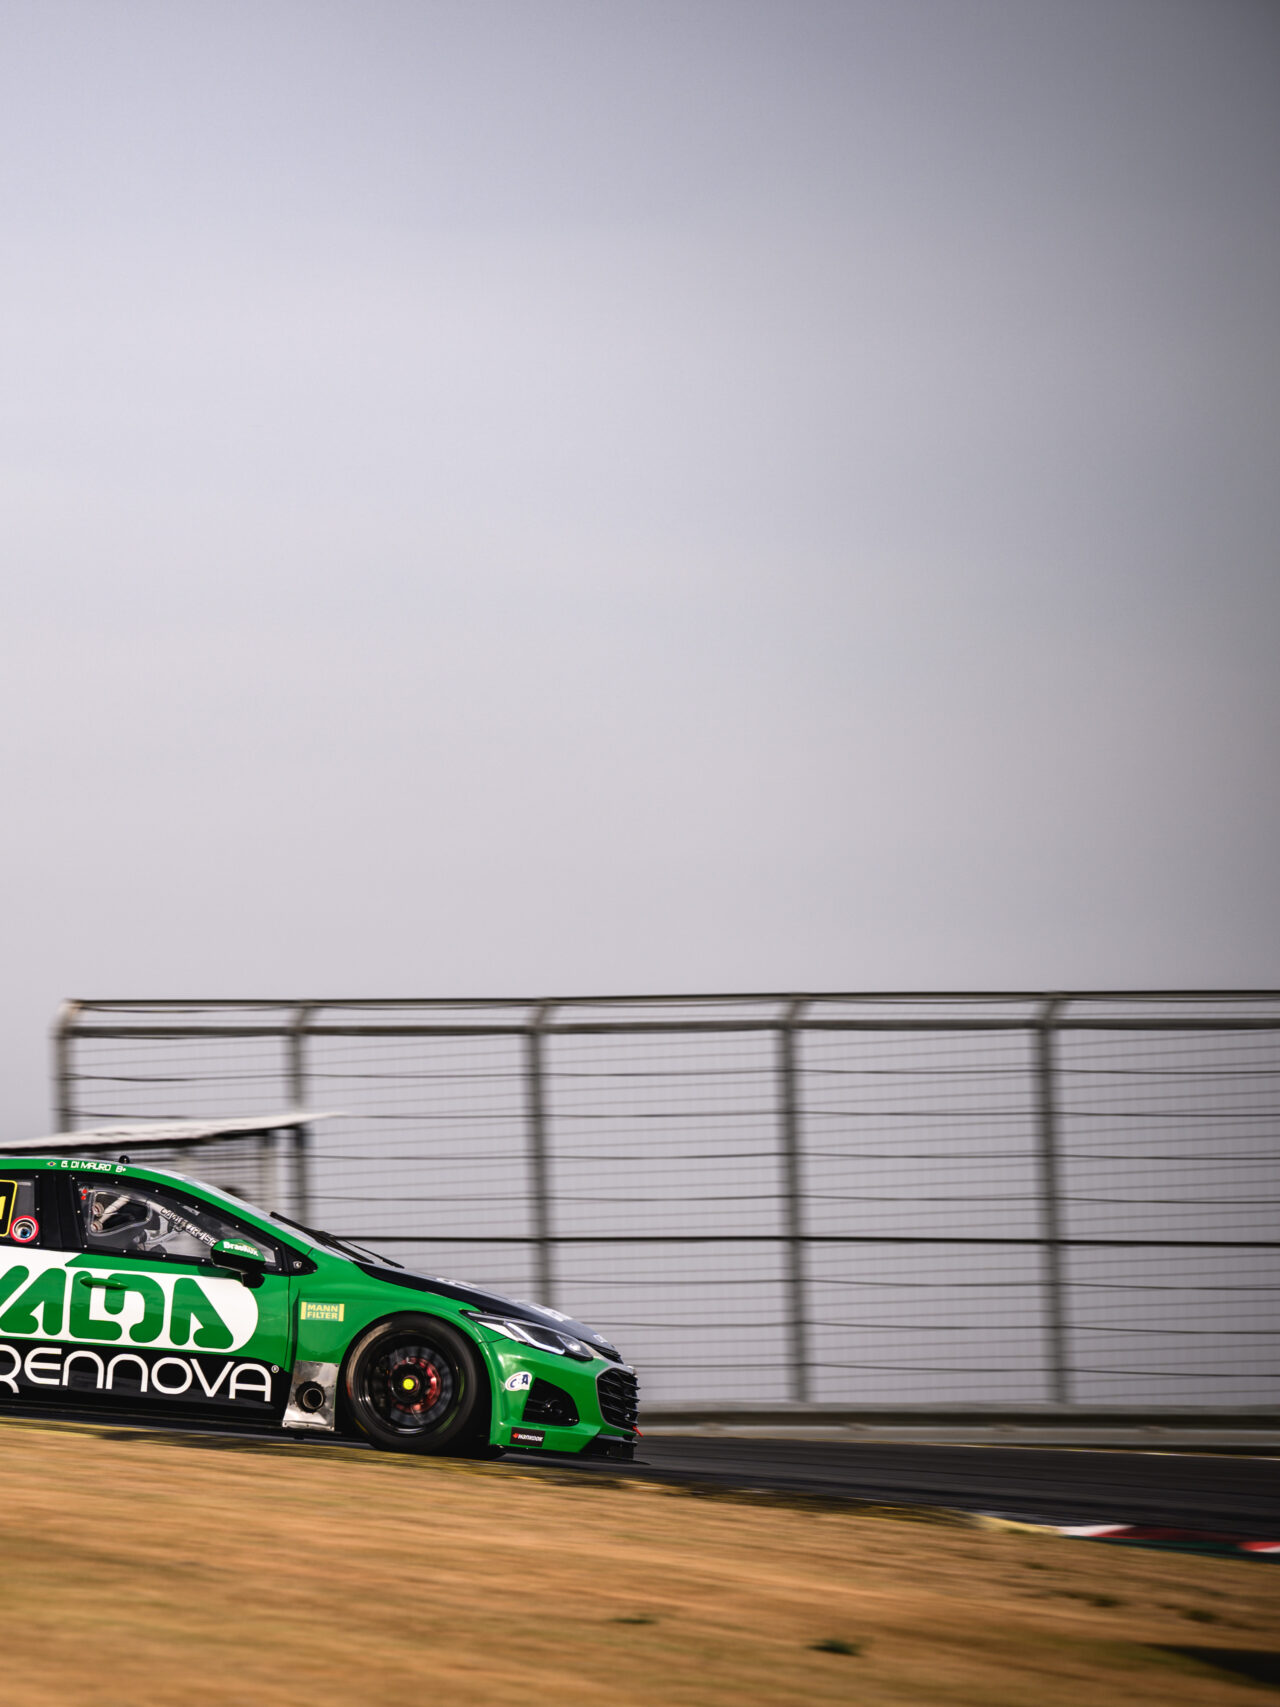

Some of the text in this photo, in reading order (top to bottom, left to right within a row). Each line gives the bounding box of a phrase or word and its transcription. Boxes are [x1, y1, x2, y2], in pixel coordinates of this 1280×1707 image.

[71, 1160, 79, 1169] DI
[81, 1161, 111, 1172] MAURO
[307, 1303, 338, 1313] MANN
[306, 1311, 338, 1320] FILTER
